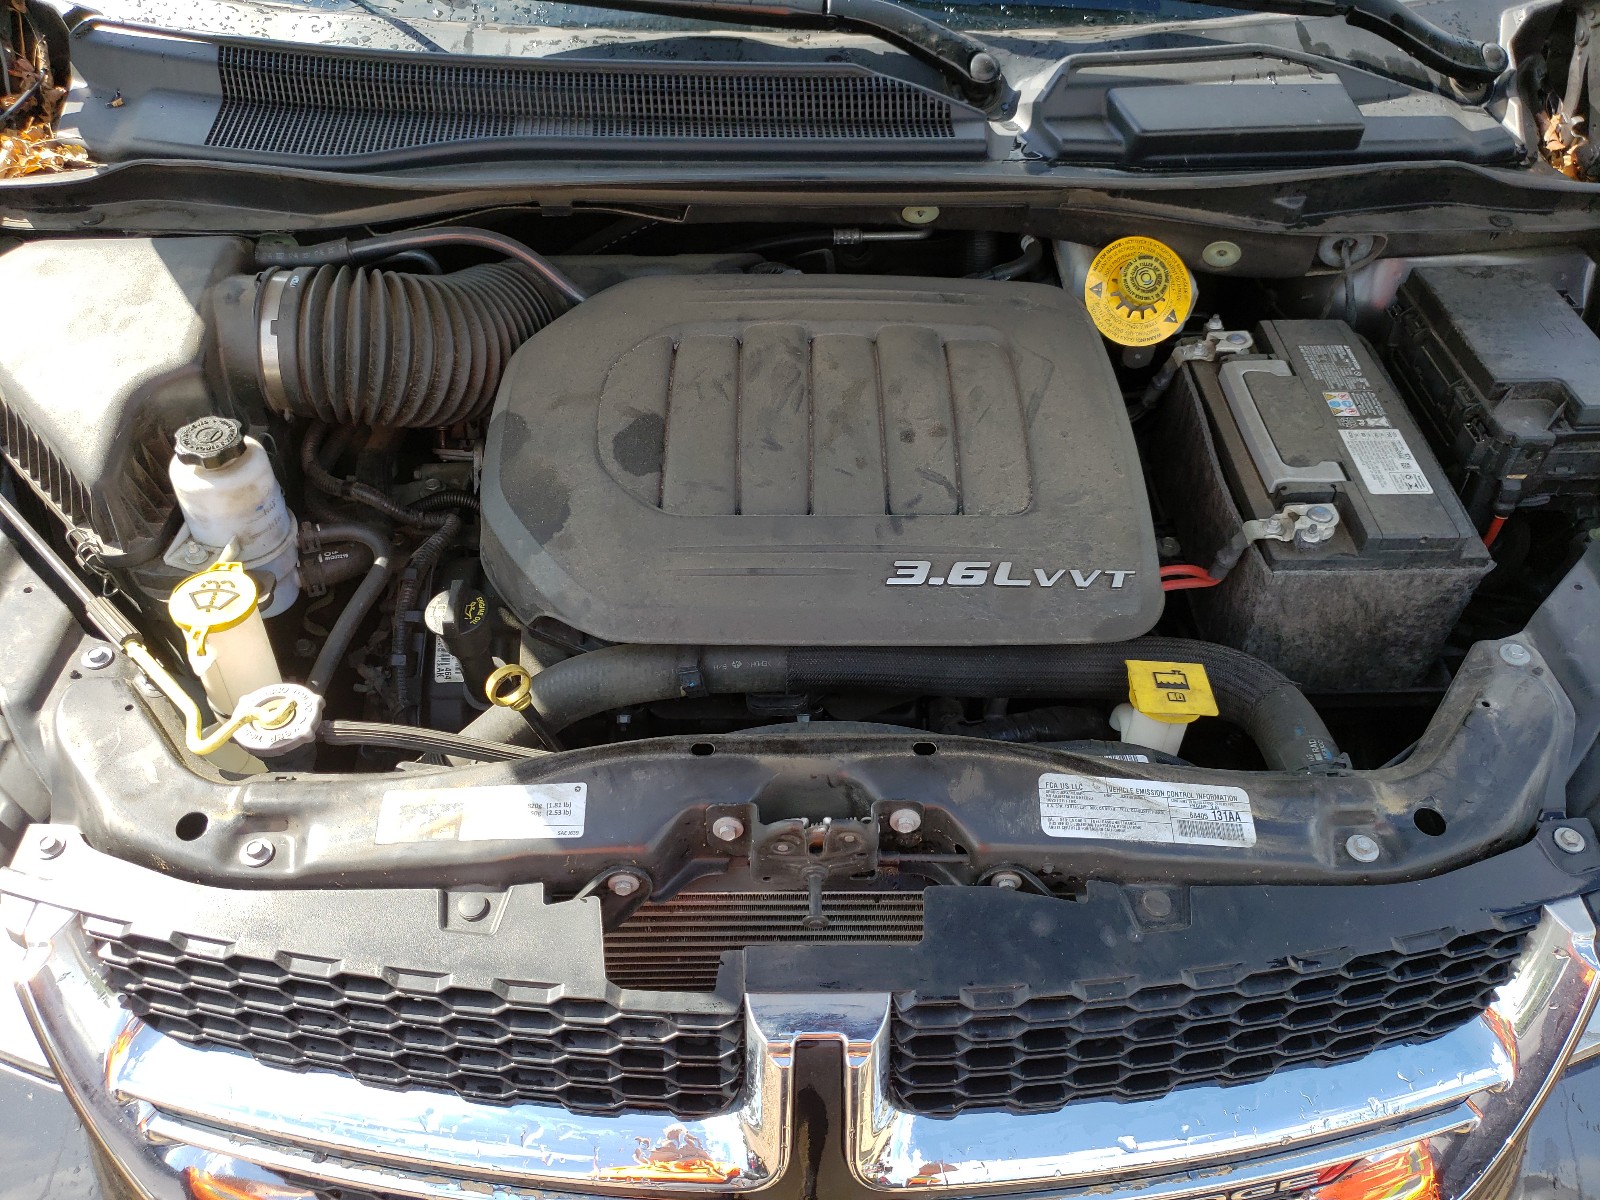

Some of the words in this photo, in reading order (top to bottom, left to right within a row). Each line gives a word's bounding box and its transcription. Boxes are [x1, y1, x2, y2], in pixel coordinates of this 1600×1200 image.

[886, 560, 1032, 586] 3.6L
[1033, 568, 1136, 588] VVT
[444, 667, 452, 680] 464
[1045, 781, 1058, 790] FCA
[1060, 782, 1070, 790] US
[1071, 783, 1083, 791] LLC
[1108, 785, 1134, 795] VEHICLE
[1135, 788, 1165, 797] EMISSION
[1166, 790, 1195, 799] CONTROL
[1195, 793, 1238, 802] INFORMATION
[563, 801, 572, 810] lb)
[1211, 810, 1242, 823] 131AA
